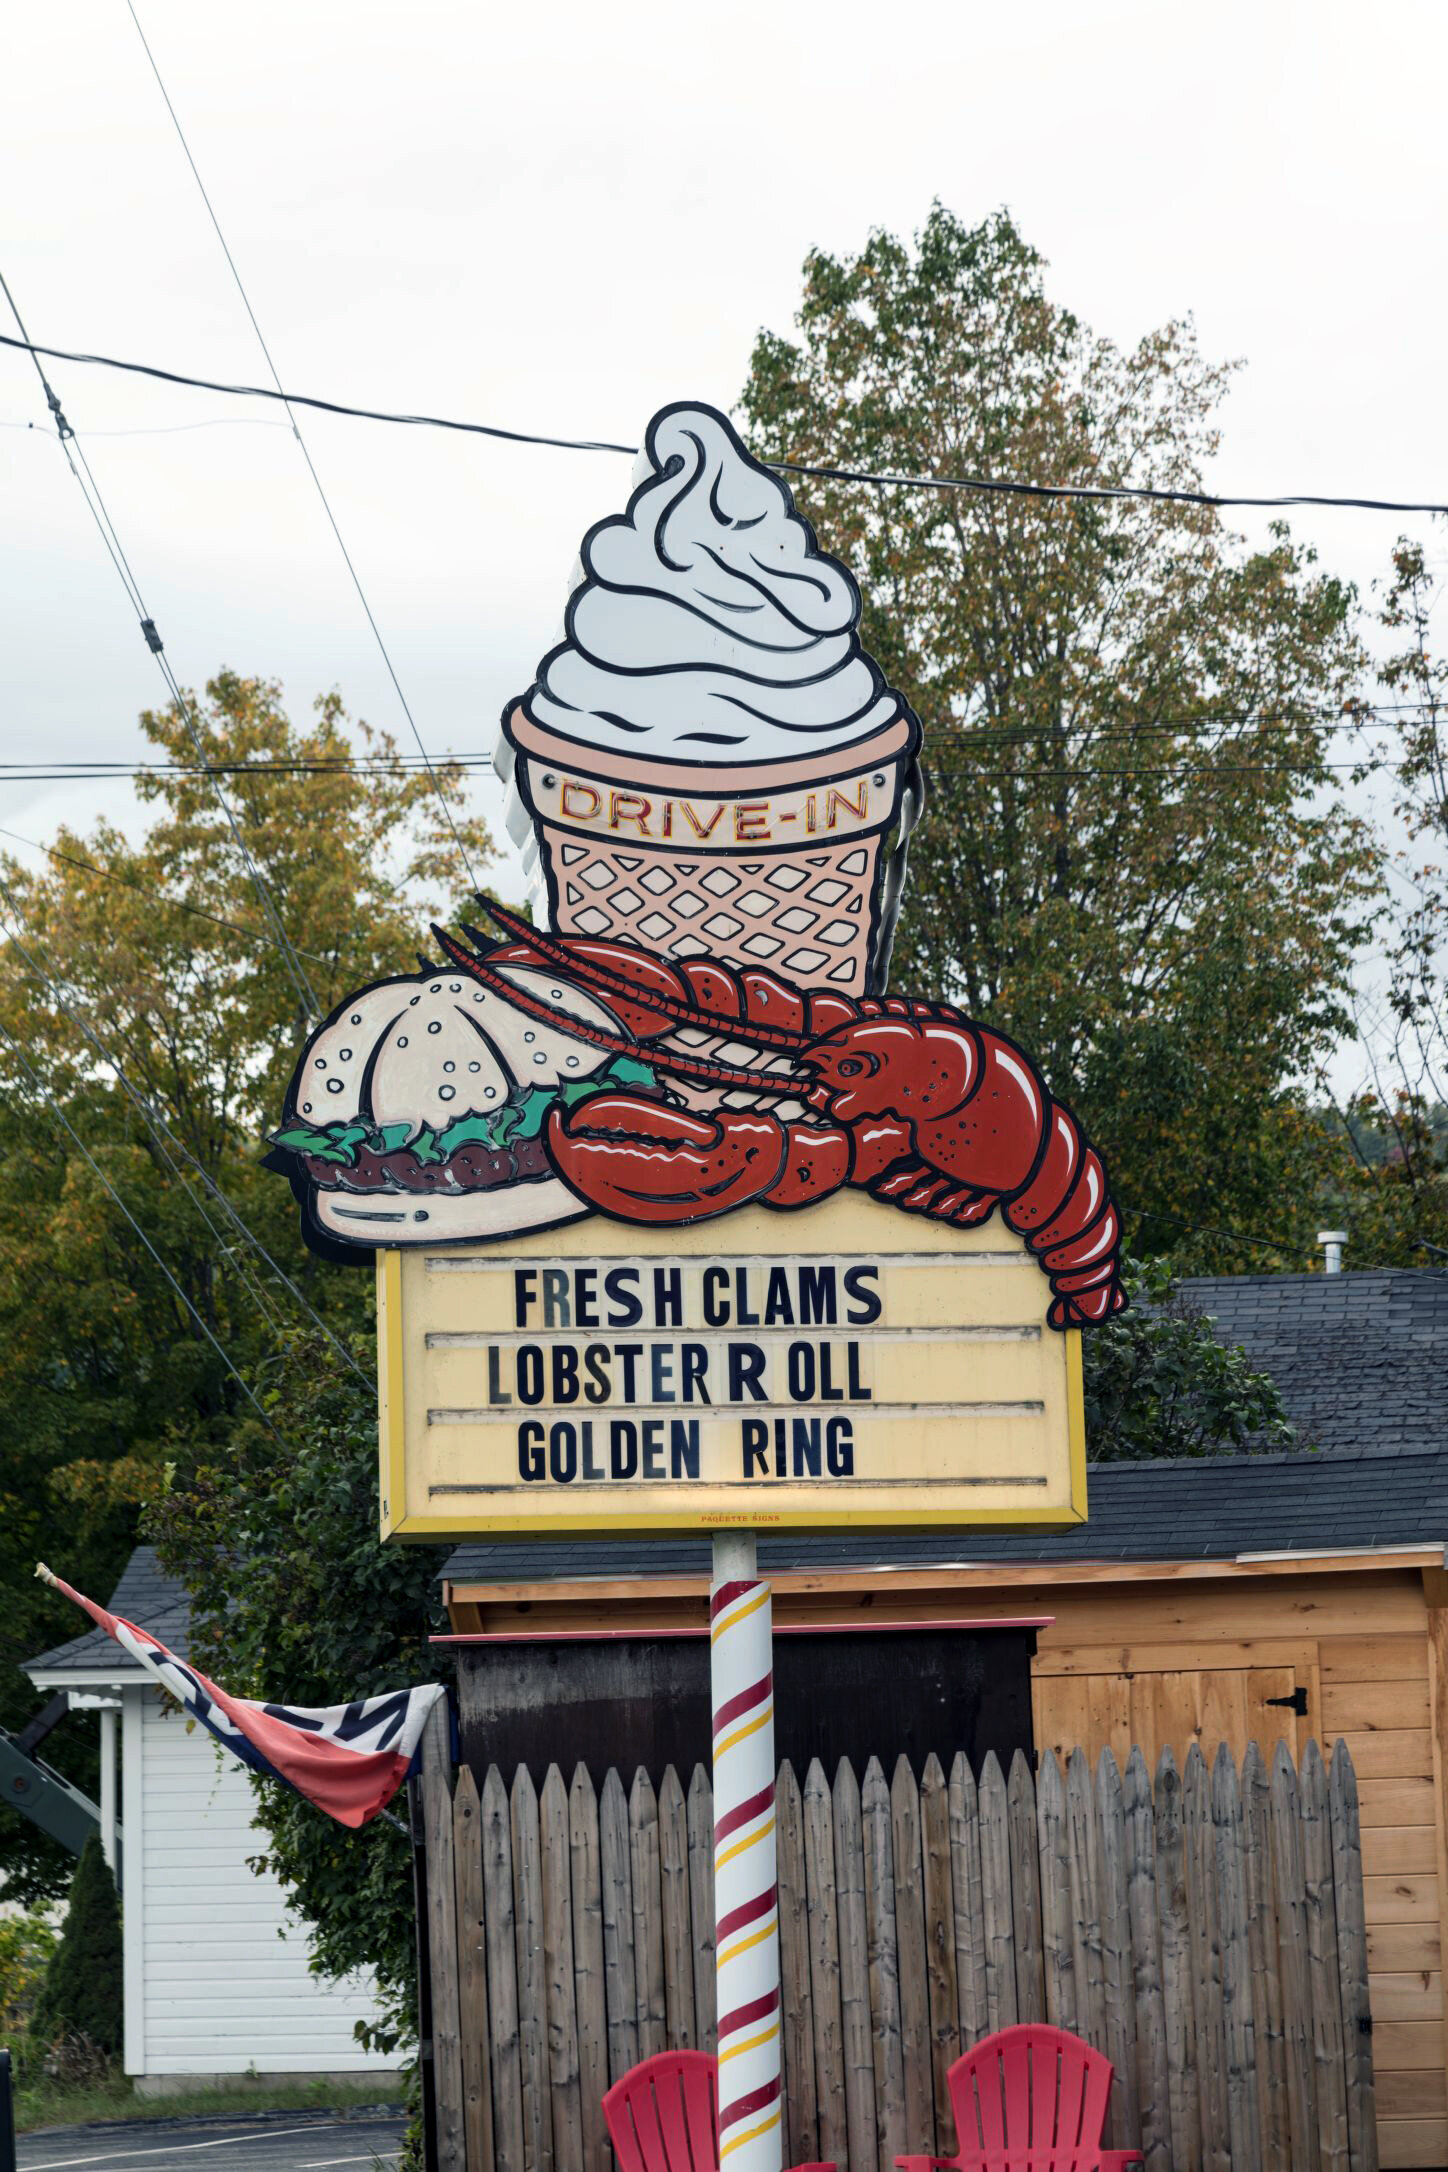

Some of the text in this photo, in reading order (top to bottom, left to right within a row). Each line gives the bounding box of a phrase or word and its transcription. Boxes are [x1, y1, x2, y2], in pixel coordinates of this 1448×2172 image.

[561, 780, 869, 841] DRIVE-IN
[514, 1265, 882, 1328] FRESH CLAMS
[488, 1341, 871, 1405] LOBSTER ROLL
[518, 1416, 855, 1484] GOLDEN RING
[701, 1515, 780, 1524] PAQUETTE SIGNS
